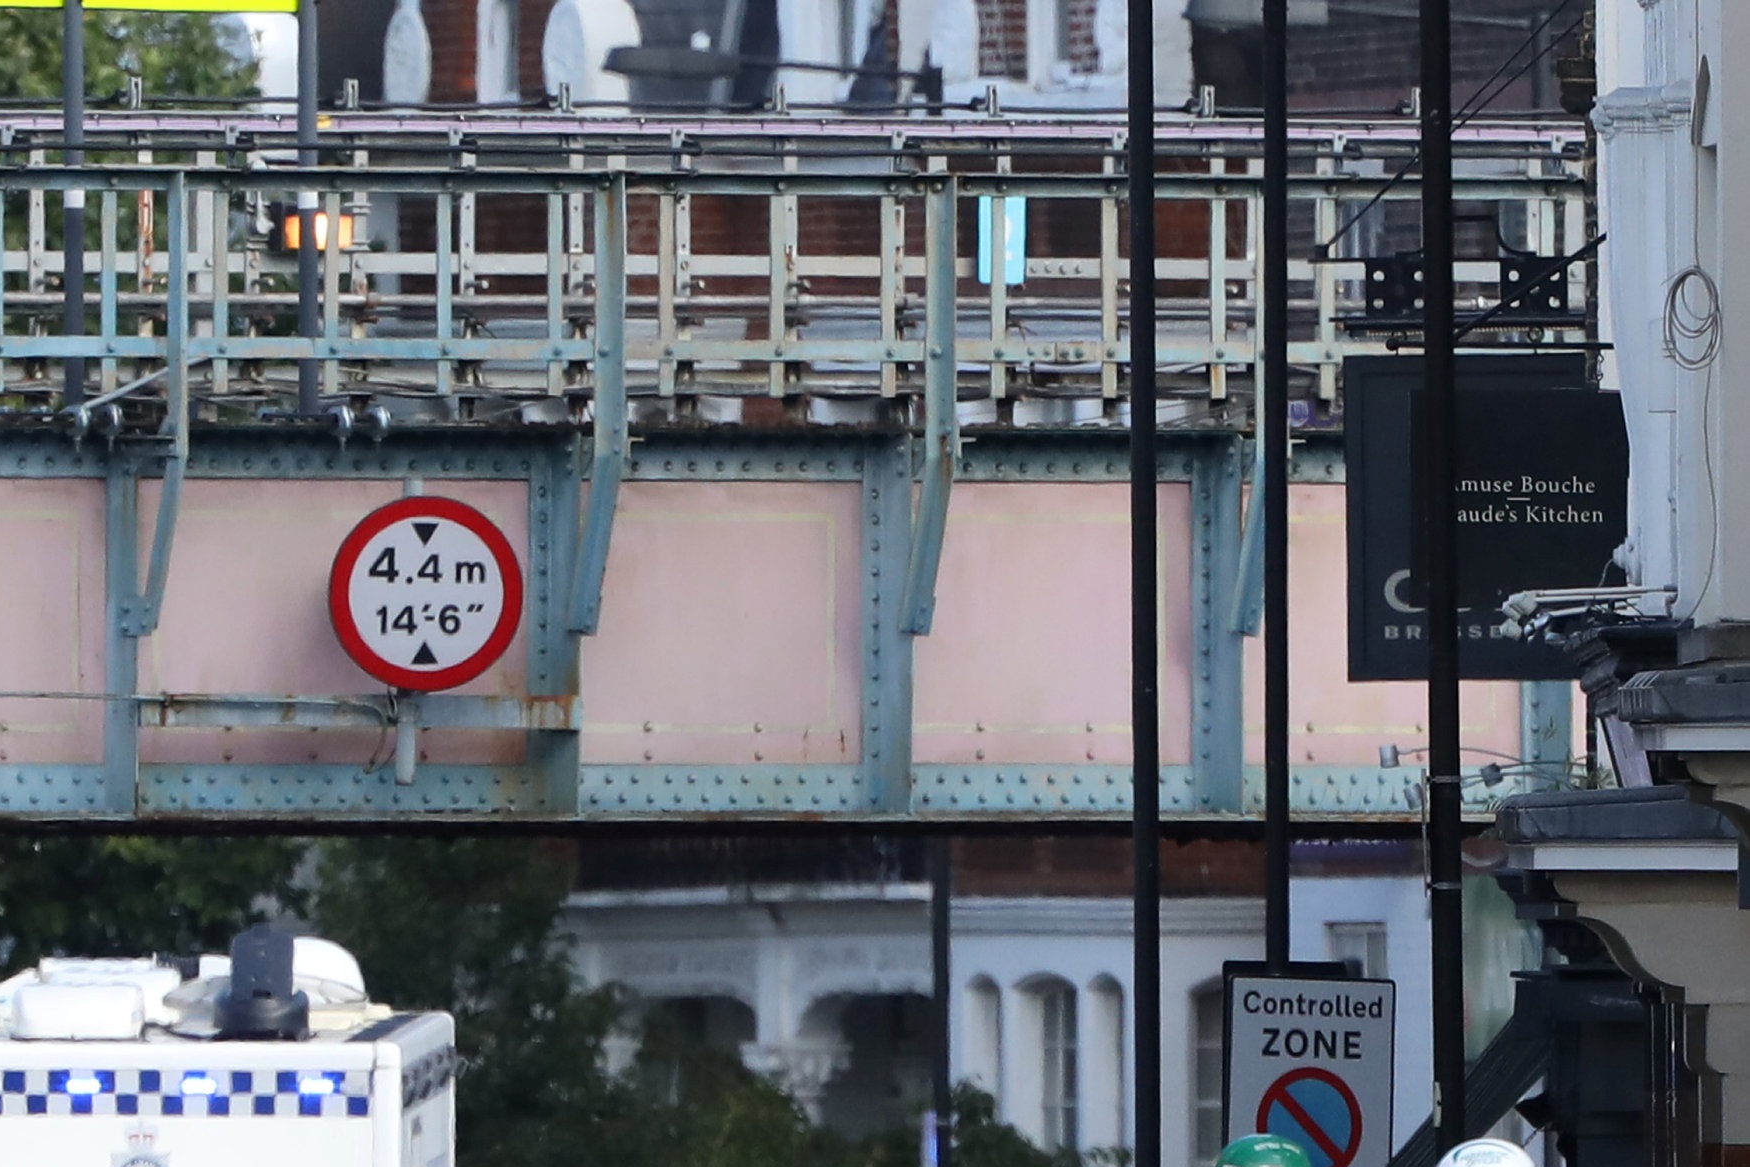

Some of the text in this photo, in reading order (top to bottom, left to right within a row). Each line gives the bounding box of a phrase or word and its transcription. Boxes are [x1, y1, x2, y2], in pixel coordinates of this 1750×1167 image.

[1455, 475, 1596, 494] muse Bouche
[1526, 503, 1603, 523] Kitchen
[368, 546, 486, 585] 4.4 m
[1243, 990, 1383, 1019] Controlled
[1261, 1027, 1362, 1060] ZONE
